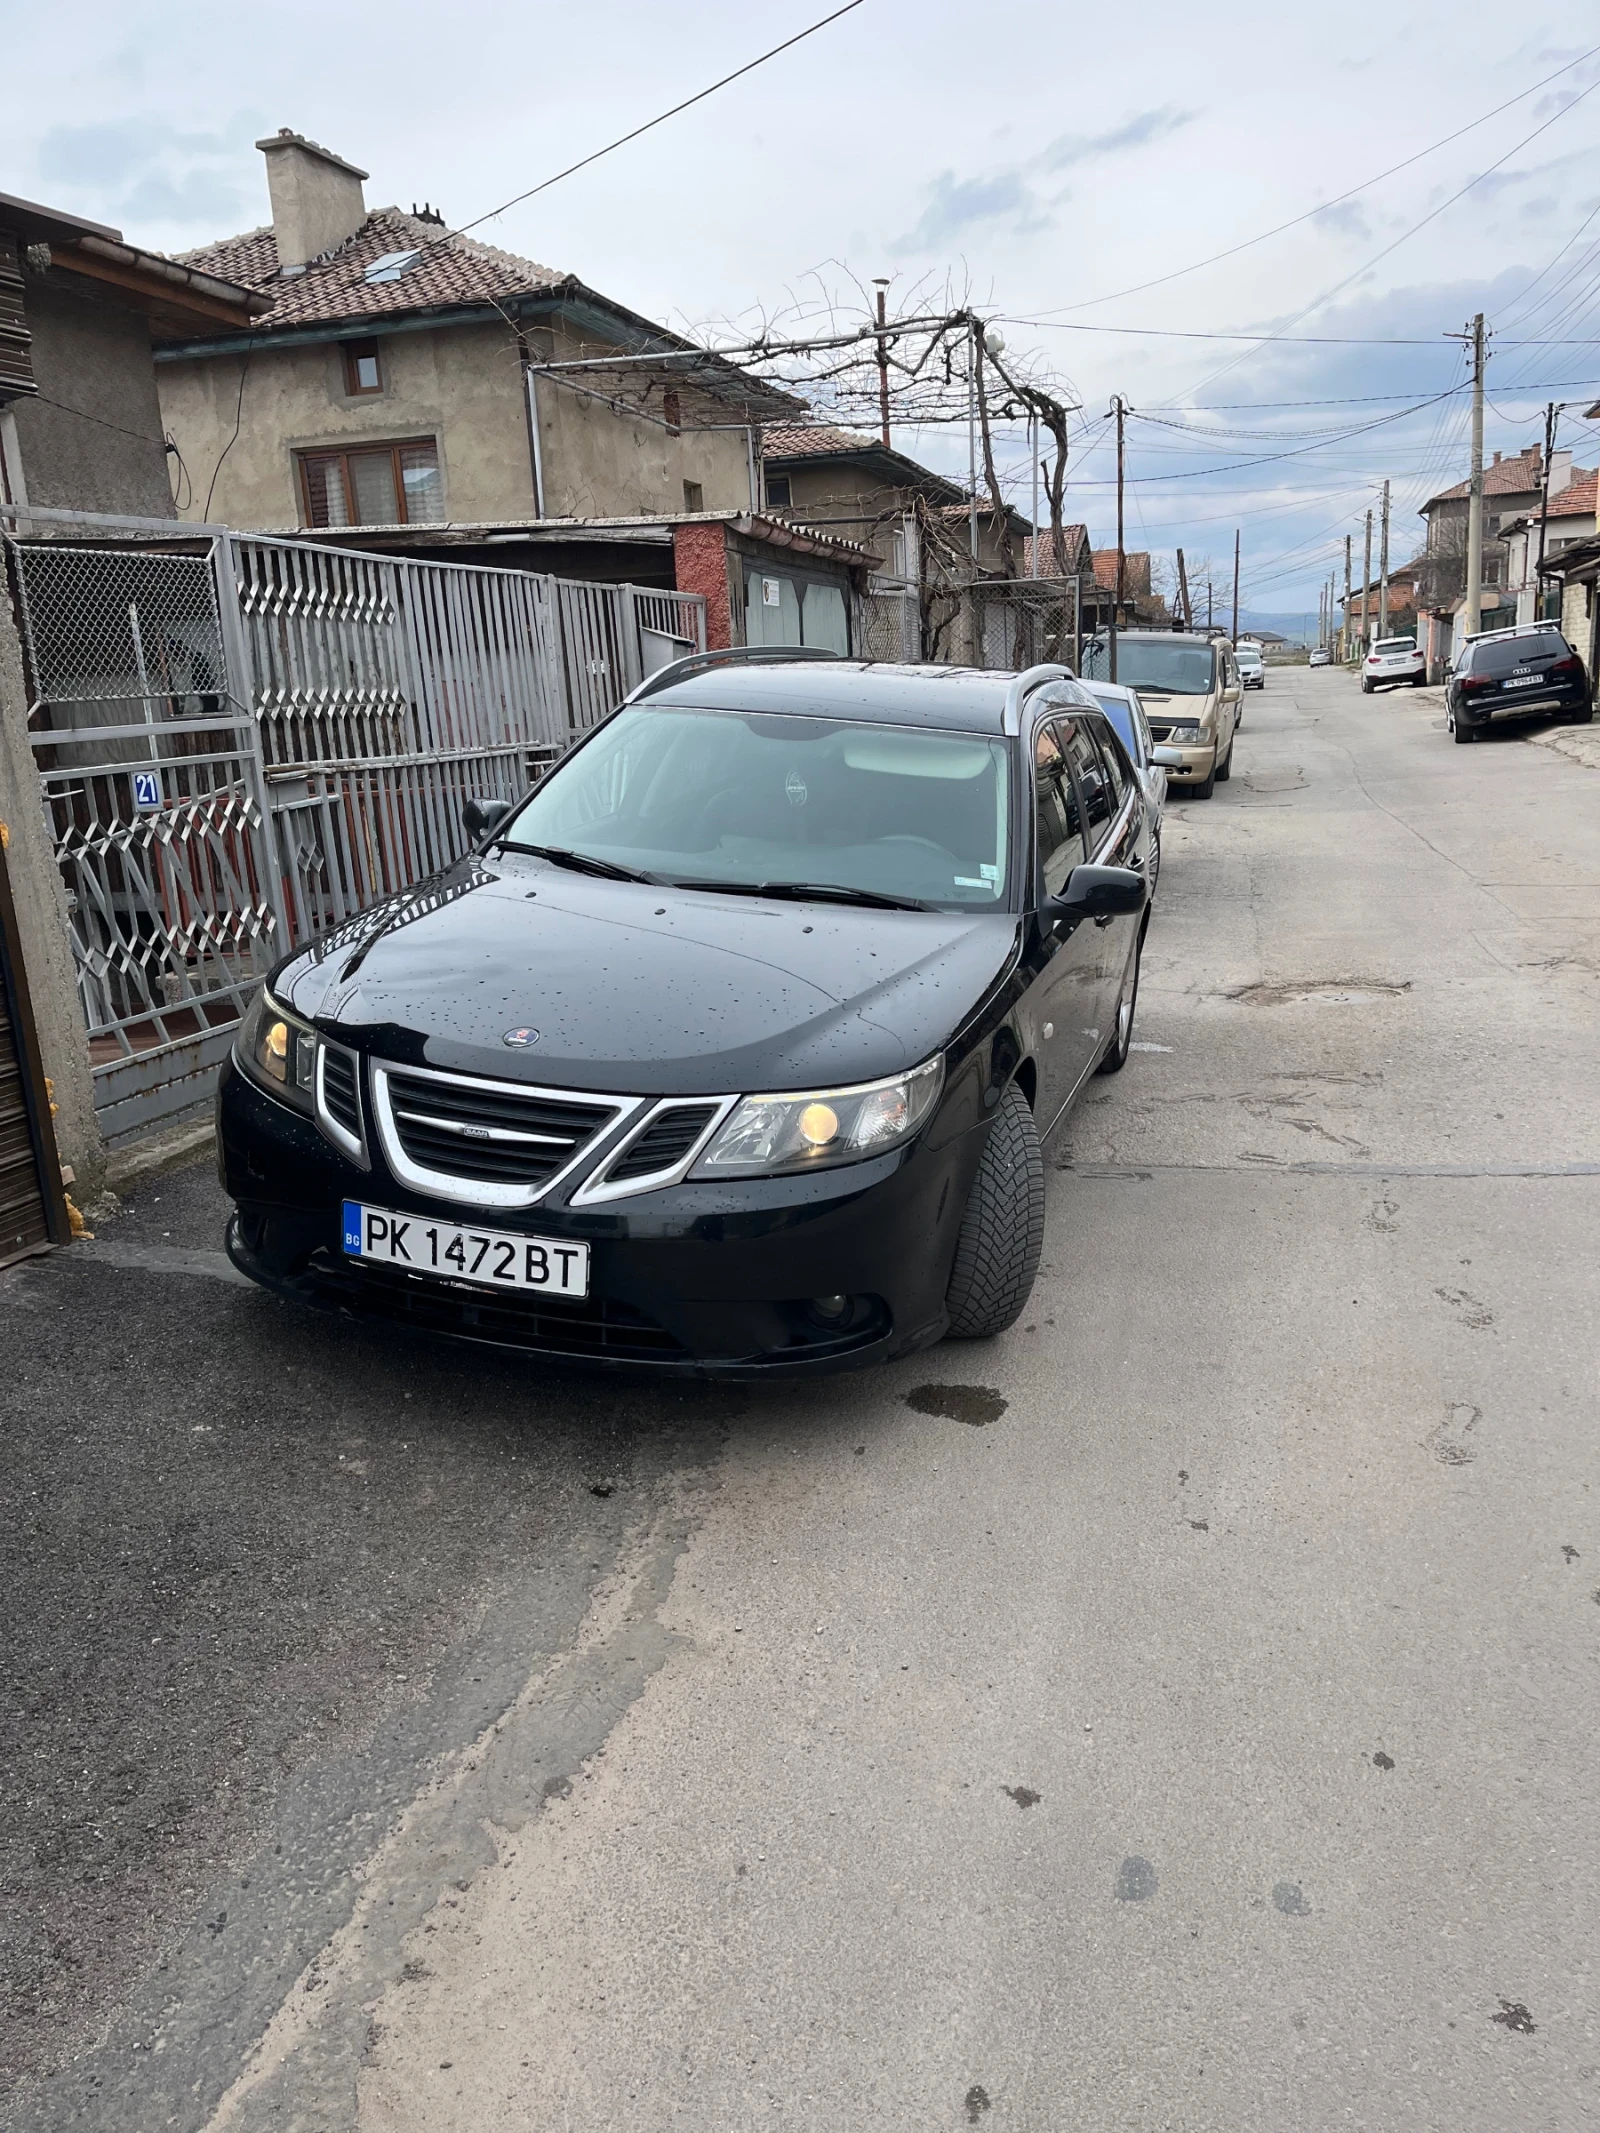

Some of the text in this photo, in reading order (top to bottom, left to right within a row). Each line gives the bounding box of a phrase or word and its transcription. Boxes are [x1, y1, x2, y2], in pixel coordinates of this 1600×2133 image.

[137, 774, 156, 802] 21
[345, 1233, 360, 1246] BG
[366, 1213, 579, 1288] PK 1472 BT
